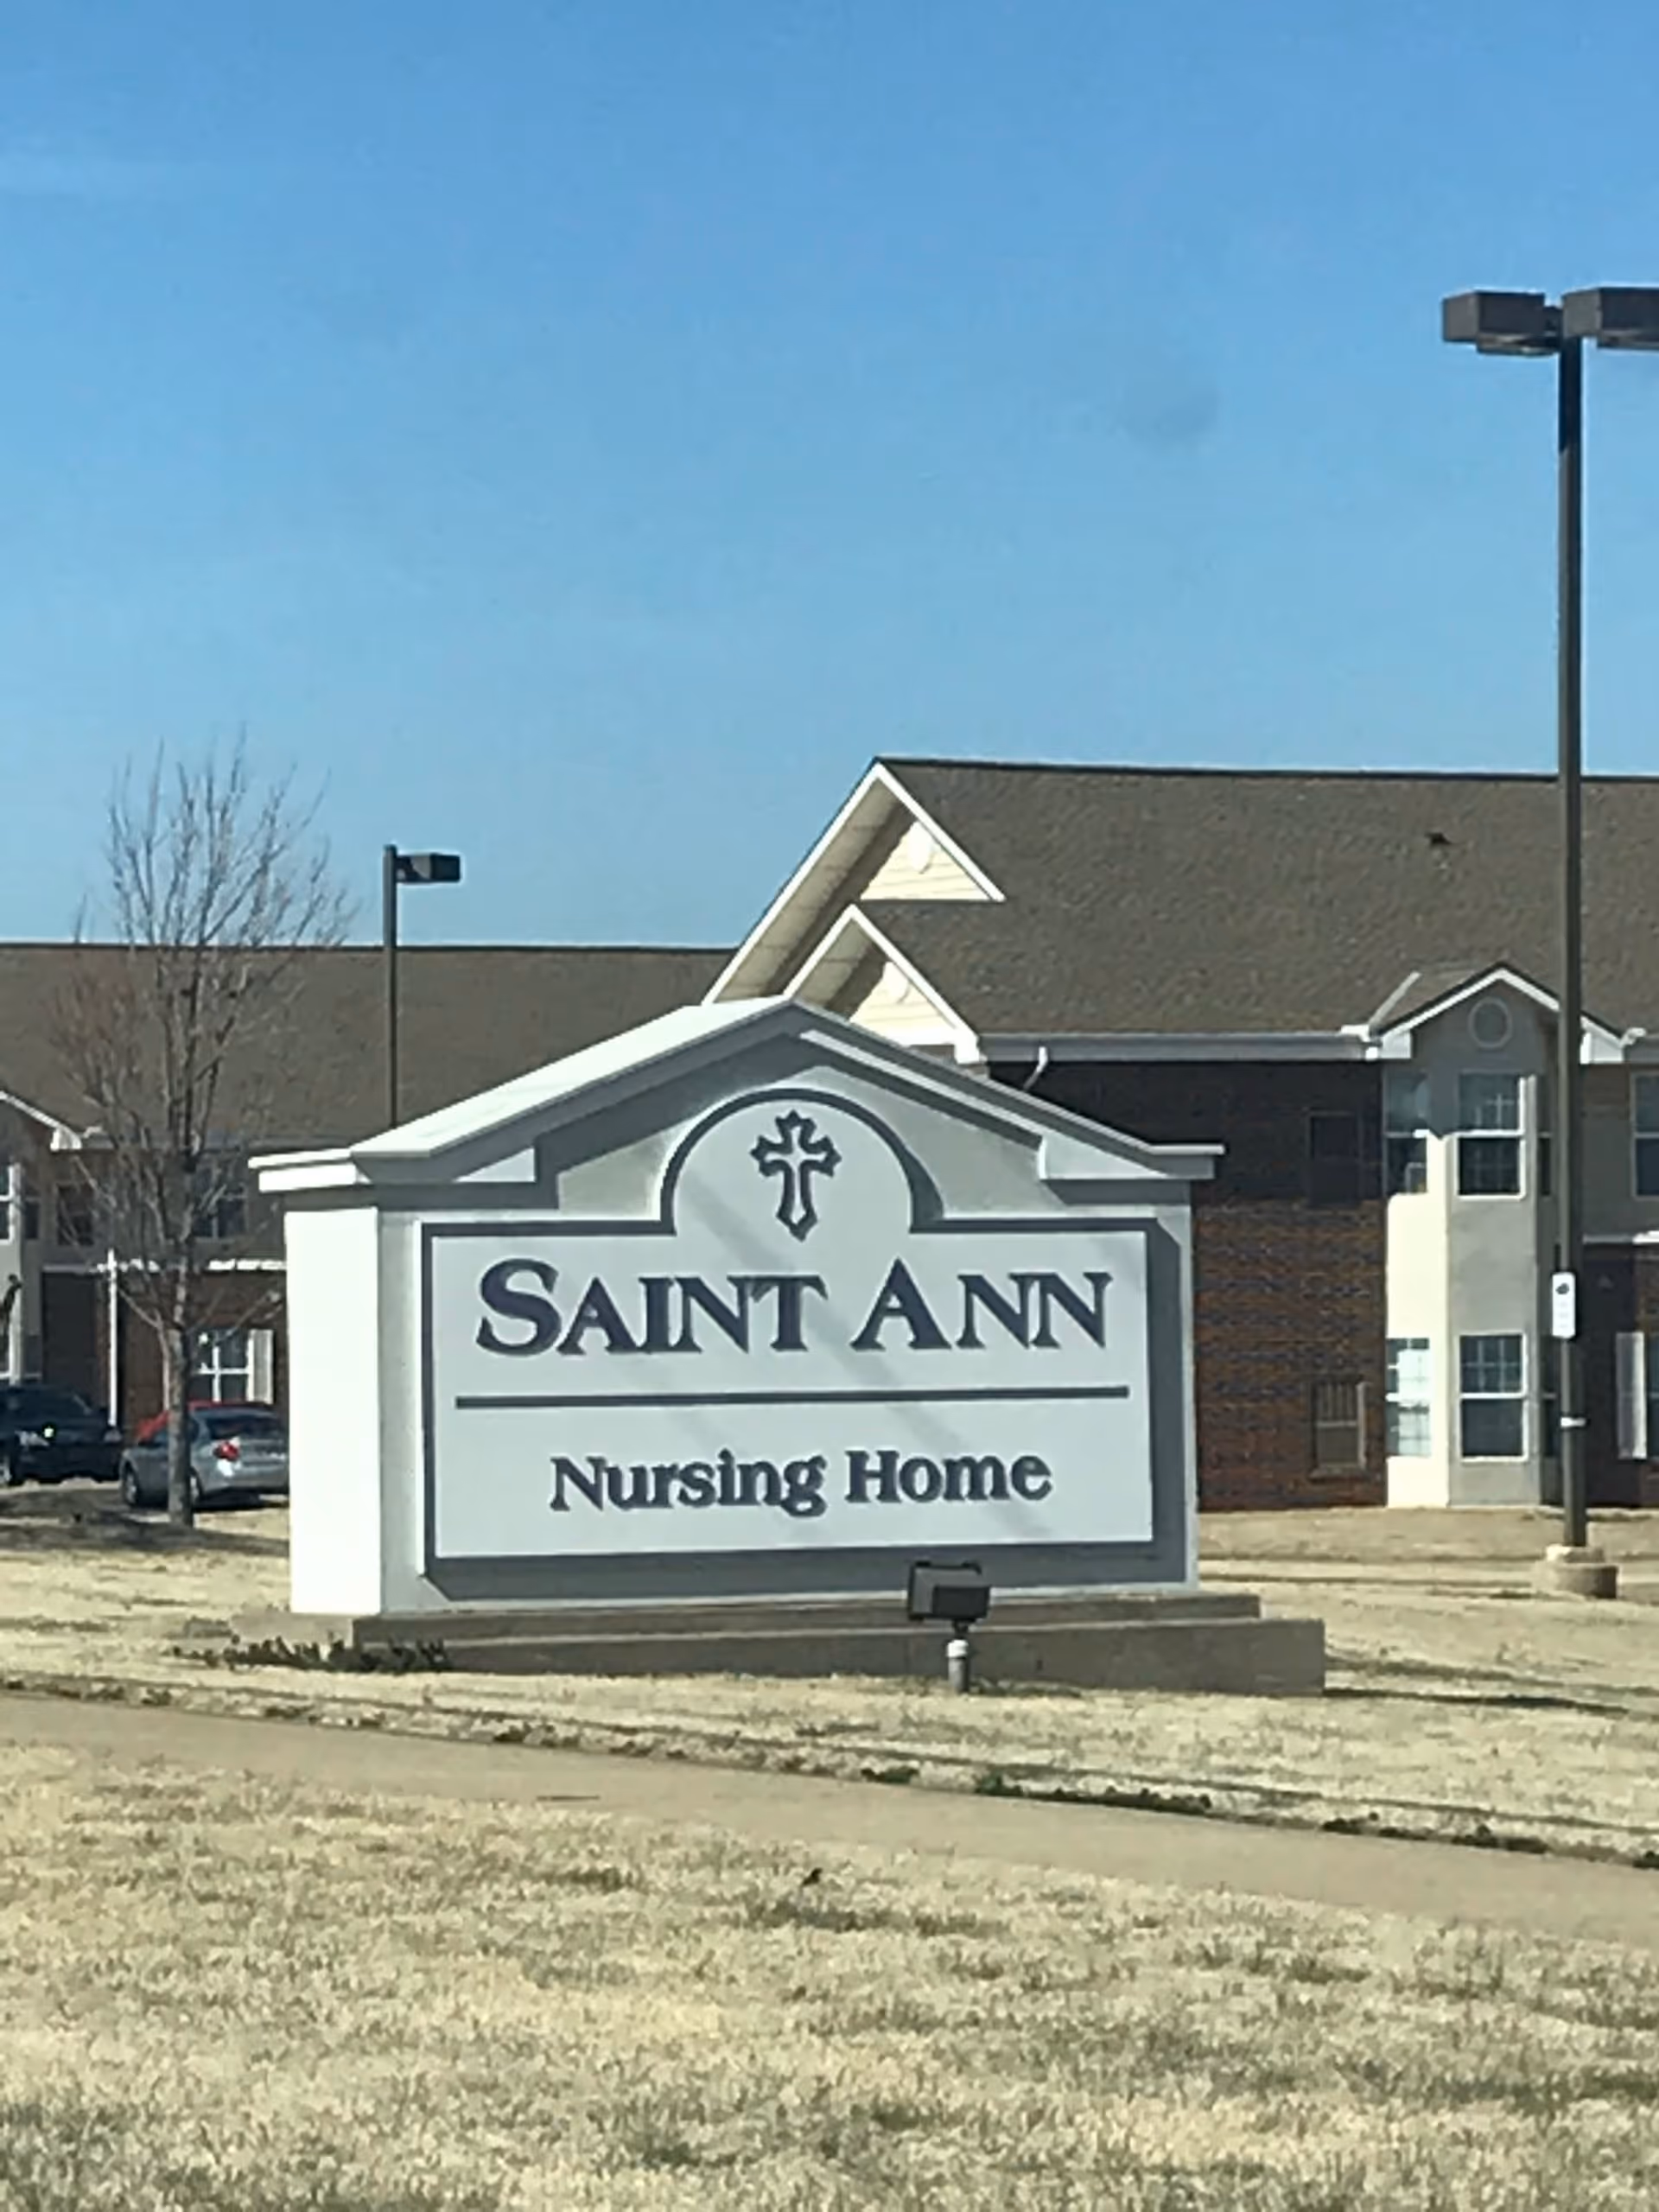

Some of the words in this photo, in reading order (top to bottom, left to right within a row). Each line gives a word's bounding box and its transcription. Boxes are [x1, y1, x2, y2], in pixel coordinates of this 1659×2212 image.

[475, 1257, 828, 1357] SAINT
[851, 1256, 1112, 1351] ANN
[550, 1449, 827, 1517] Nursing
[845, 1449, 1052, 1506] Home
